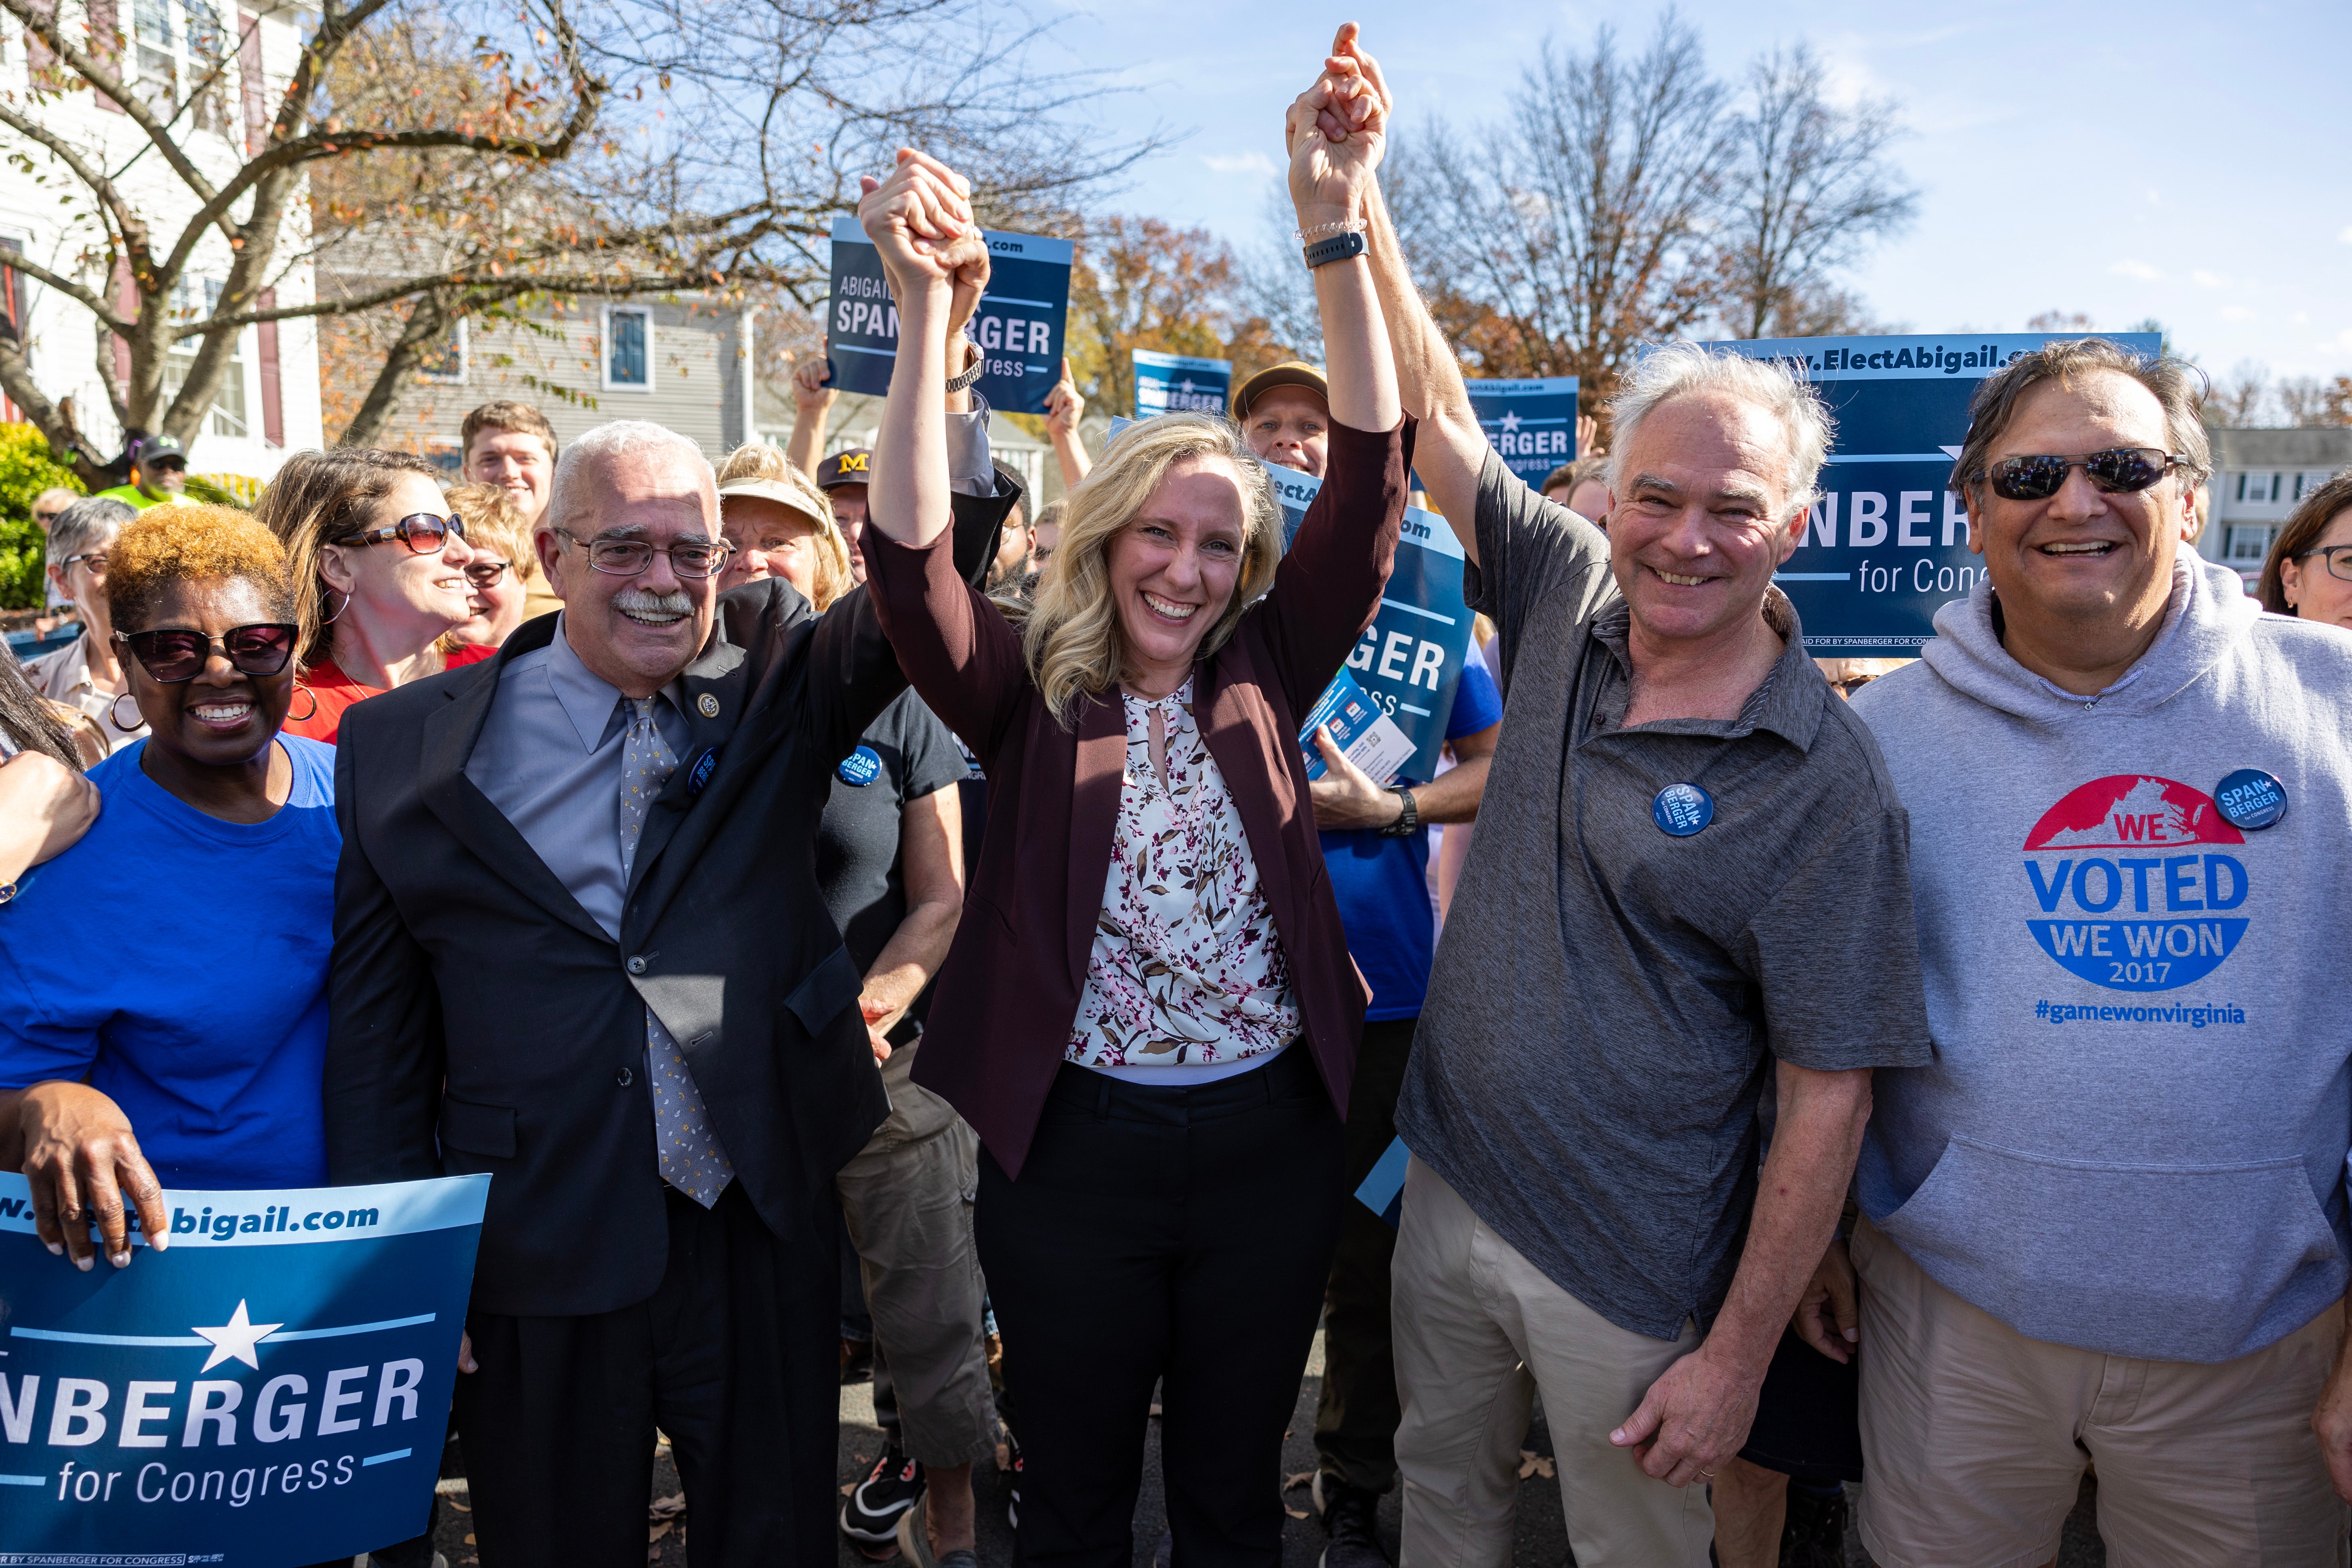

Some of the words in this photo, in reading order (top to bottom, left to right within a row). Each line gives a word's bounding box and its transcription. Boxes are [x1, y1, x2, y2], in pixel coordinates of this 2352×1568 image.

[838, 453, 869, 474] M
[1859, 560, 1902, 592] for
[1360, 687, 1396, 716] ss
[842, 759, 872, 777] BERGER
[1676, 786, 1701, 821] SPAN
[2221, 779, 2268, 806] SPAN
[2228, 791, 2279, 818] BERGER
[1663, 806, 1674, 824] CONGRESS
[1665, 790, 1688, 829] BERGER
[2251, 806, 2275, 819] CONGRESS
[2113, 813, 2167, 841] WE
[2024, 854, 2249, 913] VOTED
[2049, 924, 2113, 957] WE
[2123, 923, 2224, 957] WON
[2109, 962, 2171, 984] 2017
[2035, 999, 2246, 1029] #gamewonvirginia
[58, 1461, 122, 1502] for
[136, 1455, 354, 1507] Congress
[27, 1556, 98, 1564] SPANBERGER
[101, 1556, 122, 1564] FOR
[125, 1555, 183, 1564] CONGRESS
